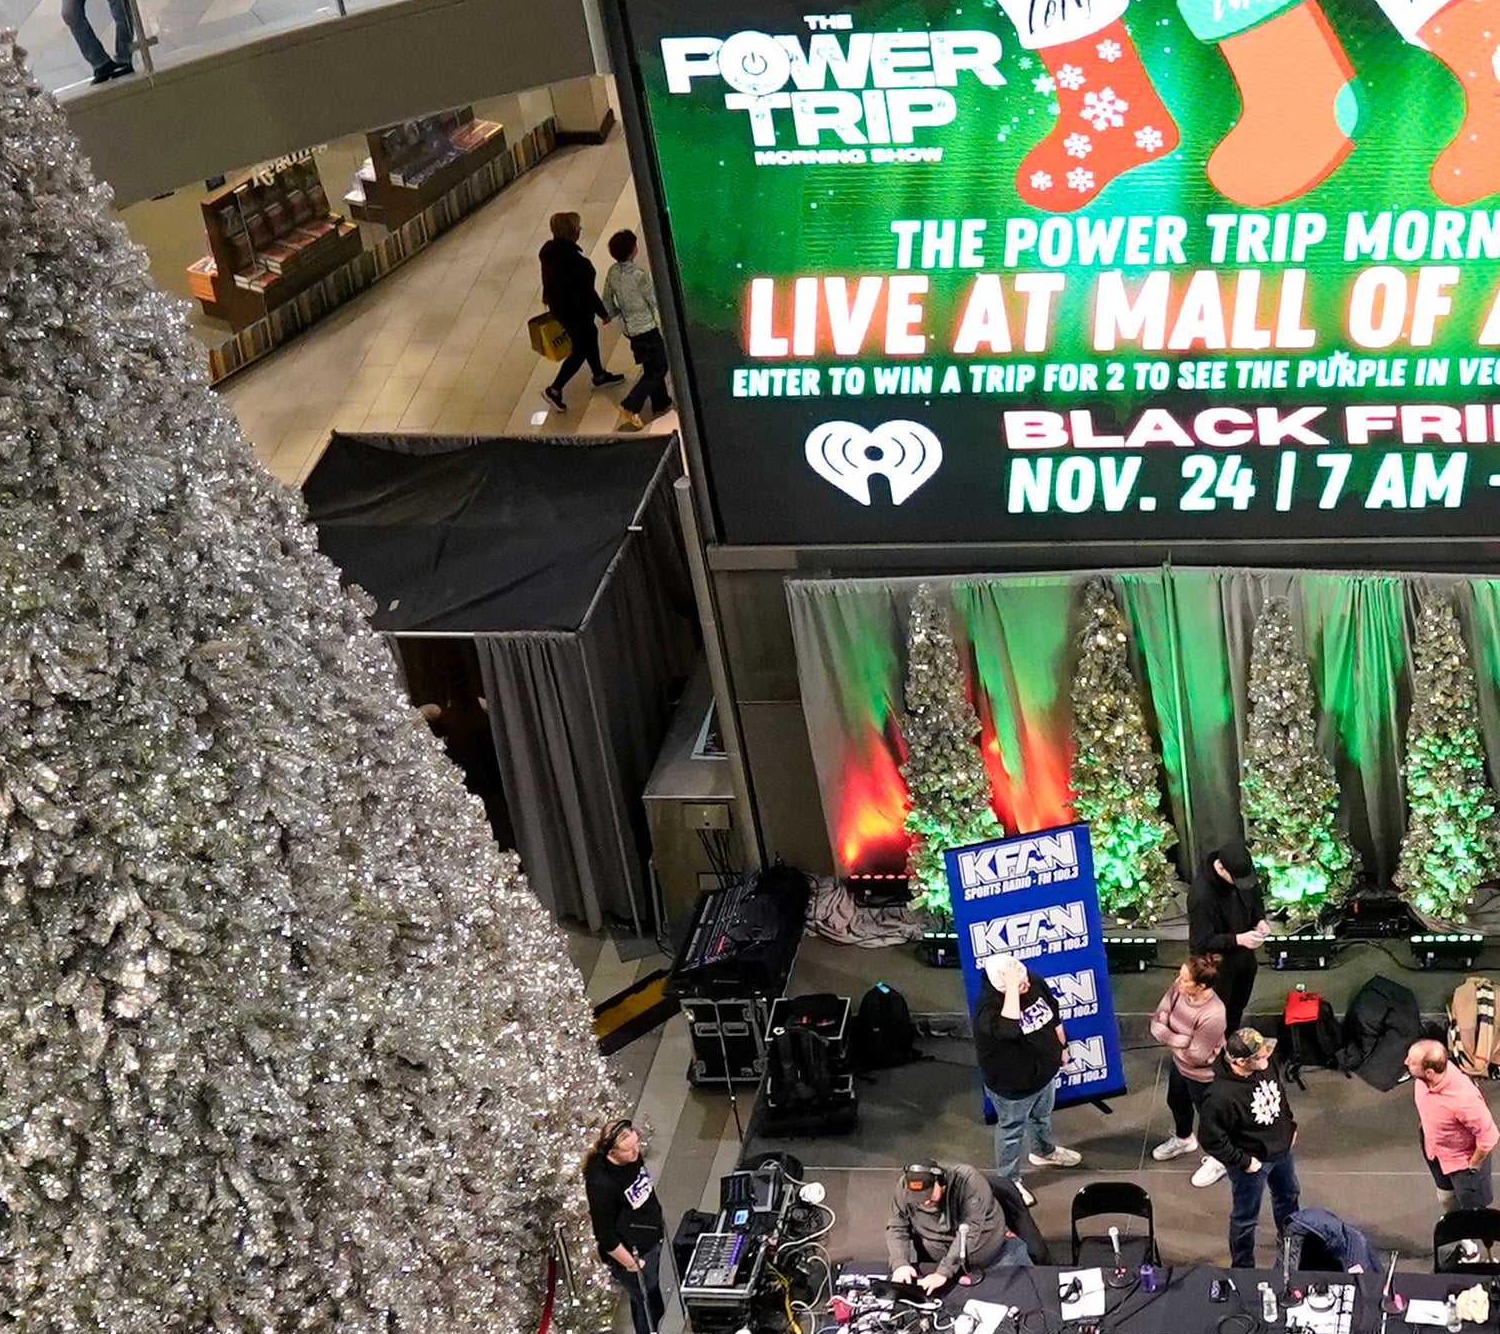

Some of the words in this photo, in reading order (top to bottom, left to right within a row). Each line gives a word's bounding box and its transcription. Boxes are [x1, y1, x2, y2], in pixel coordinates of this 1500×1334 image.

[803, 14, 853, 30] THE
[660, 29, 1008, 97] POWER
[724, 87, 958, 147] TRIP
[753, 148, 867, 166] MORNING
[870, 146, 944, 164] SHOW
[891, 218, 988, 269] THE
[1004, 215, 1188, 267] POWER
[1206, 213, 1328, 264] TRIP
[748, 274, 929, 357] LIVE
[953, 271, 1066, 354] AT
[1094, 268, 1319, 353] MALL
[1348, 265, 1462, 350] OF
[732, 368, 821, 397] ENTER
[828, 367, 866, 396] TO
[873, 366, 934, 395] WIN
[940, 366, 960, 394] A
[969, 364, 1036, 393] TRIP
[1044, 363, 1097, 392] FOR
[1105, 362, 1125, 391] 2
[1134, 361, 1169, 390] TO
[1177, 361, 1228, 390] SEE
[1236, 360, 1289, 389] THE
[1297, 358, 1407, 389] PURPLE
[1415, 357, 1449, 387] IN
[1002, 405, 1328, 450] BLACK
[1007, 455, 1157, 514] NOV.
[1180, 453, 1257, 512] 24
[1316, 452, 1352, 510] 7
[1363, 450, 1468, 510] AM
[957, 830, 1079, 889] KFAN
[964, 879, 1001, 901] SPORTS
[1002, 875, 1032, 894] RADIO
[1038, 871, 1052, 886] FM
[1053, 866, 1079, 882] 100.3
[969, 900, 1089, 958] KFAN
[1048, 940, 1062, 954] FM
[1063, 935, 1089, 951] 100.3
[1073, 1002, 1099, 1018] 100.3
[1068, 1072, 1081, 1086] FM
[1083, 1067, 1108, 1083] 100.3
